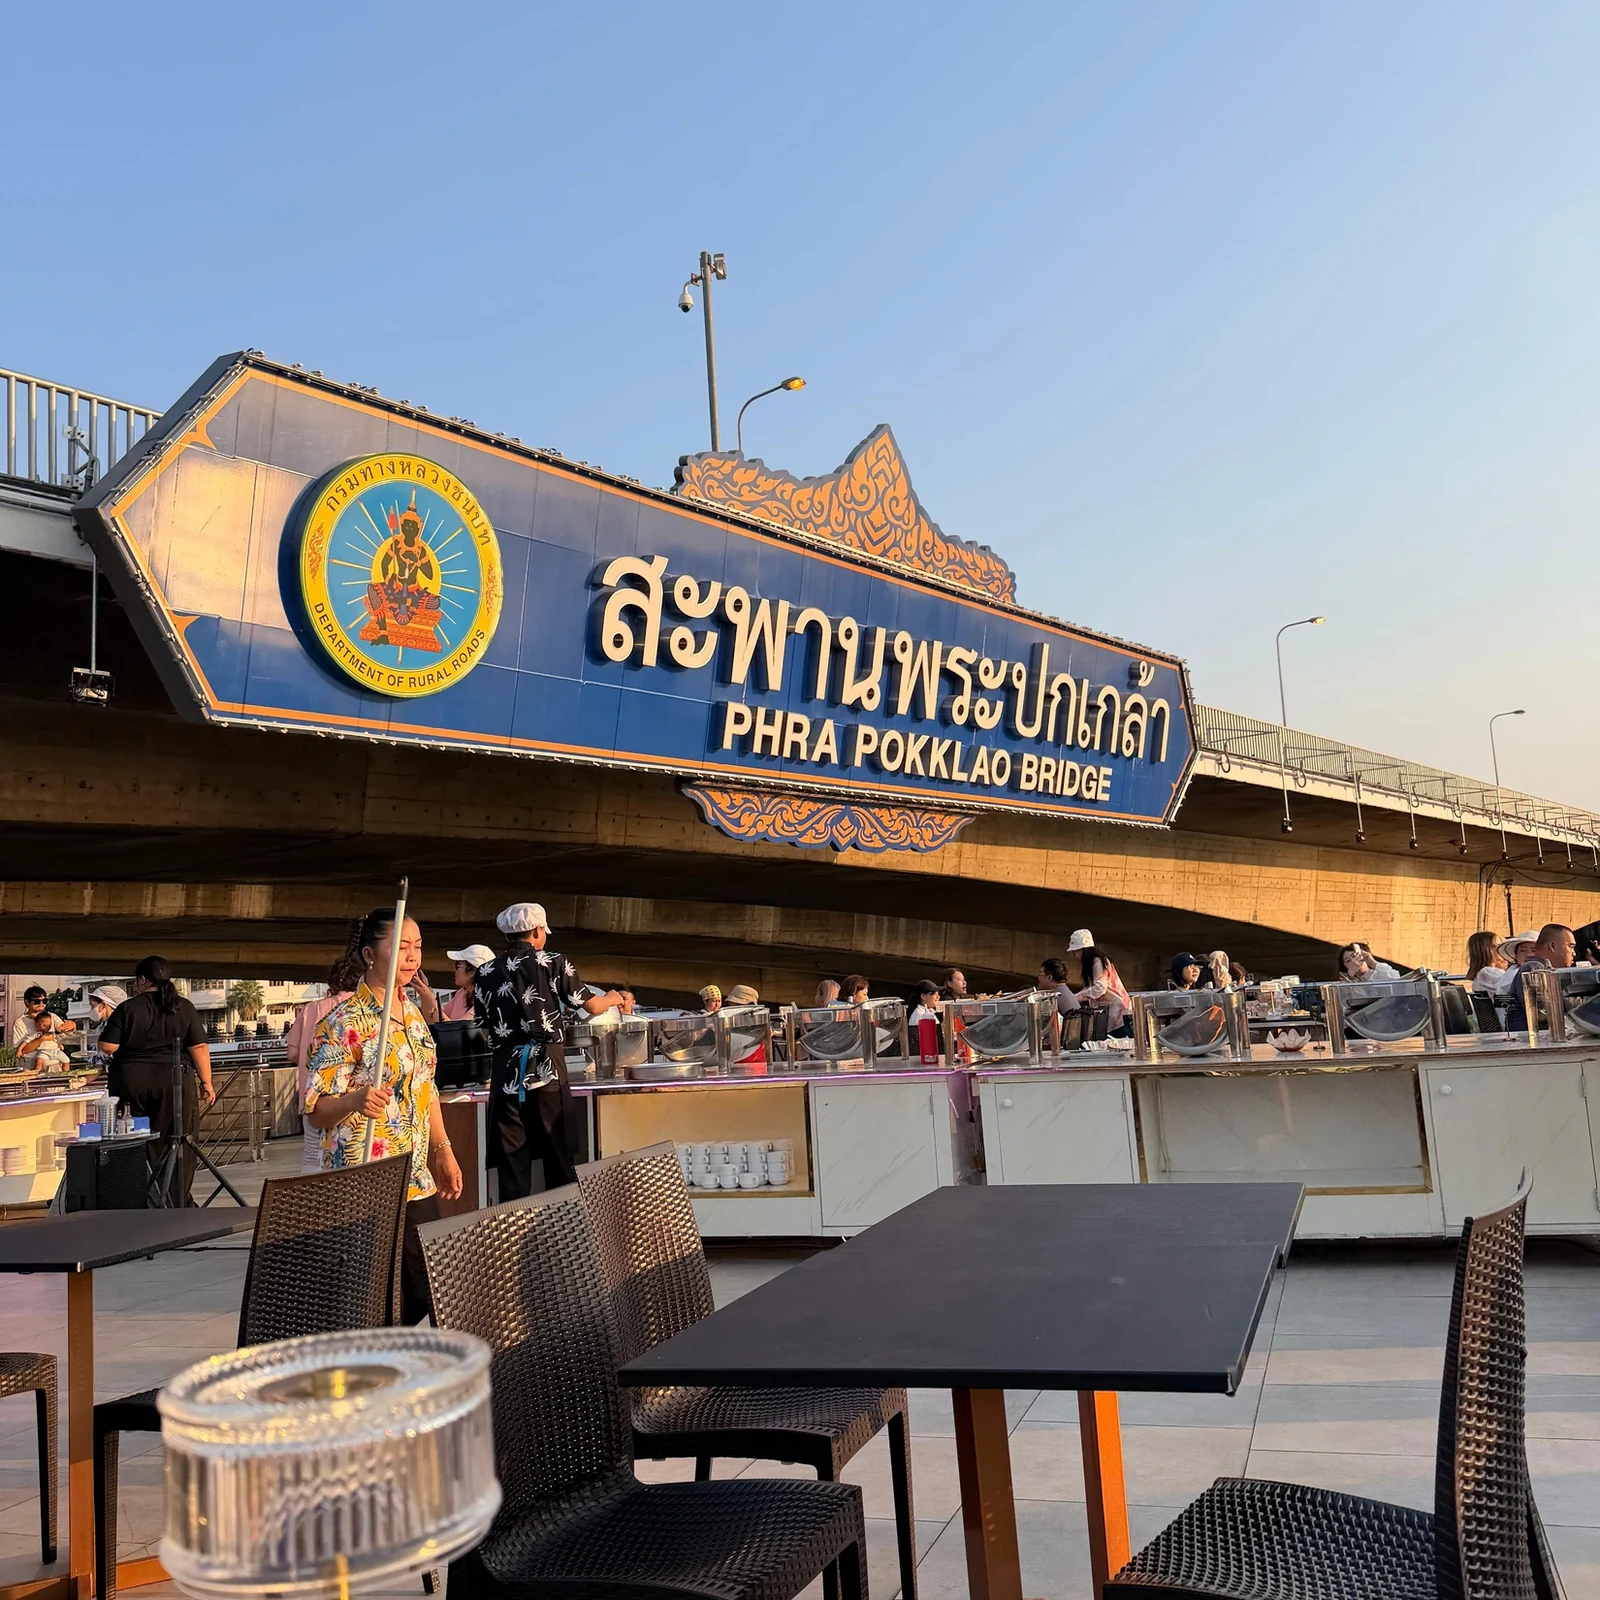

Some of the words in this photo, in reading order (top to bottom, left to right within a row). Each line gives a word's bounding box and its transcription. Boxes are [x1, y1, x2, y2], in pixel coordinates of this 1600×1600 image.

[325, 460, 491, 547] กรมทางหลวงชนบท
[314, 602, 384, 682] DEPARTMENT
[386, 674, 404, 688] OF
[408, 670, 451, 688] RURAL
[452, 629, 485, 669] ROADS
[601, 554, 1170, 763] สะพานพระปกเกล้า
[722, 702, 838, 764] PHRA
[854, 725, 1010, 786] POKKLAO
[1019, 755, 1112, 801] BRIDGE
